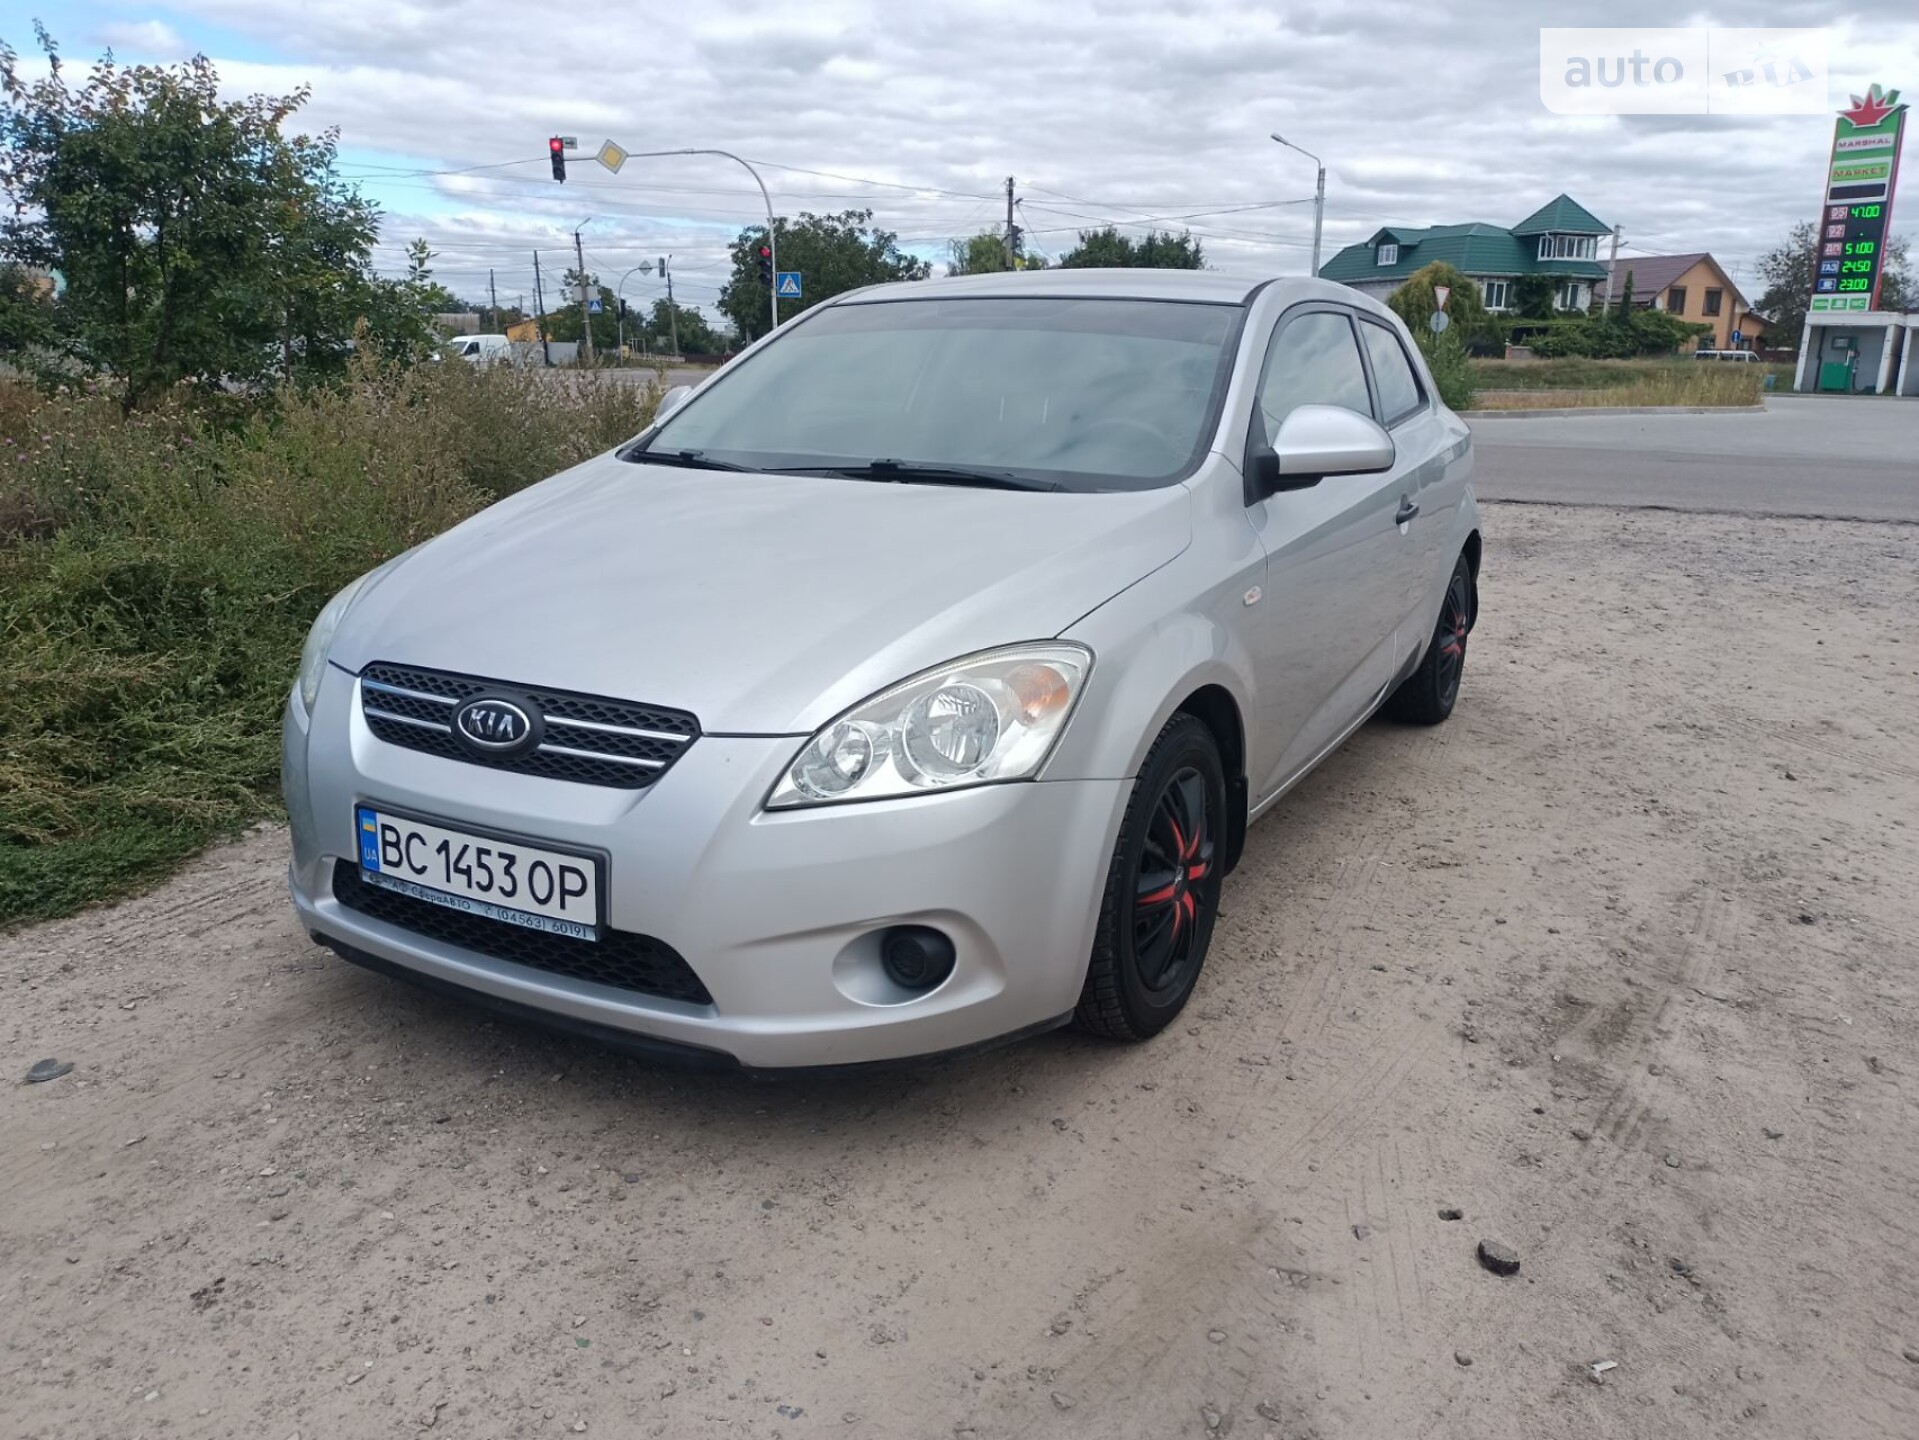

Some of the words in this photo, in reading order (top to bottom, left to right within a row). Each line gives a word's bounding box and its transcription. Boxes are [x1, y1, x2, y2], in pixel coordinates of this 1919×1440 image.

[1838, 137, 1891, 149] MARSHAL
[1833, 166, 1886, 178] MARKET
[467, 707, 514, 739] KIA
[364, 847, 378, 863] UA
[380, 823, 428, 875] BC
[435, 839, 518, 898] 1453
[528, 860, 588, 910] OP
